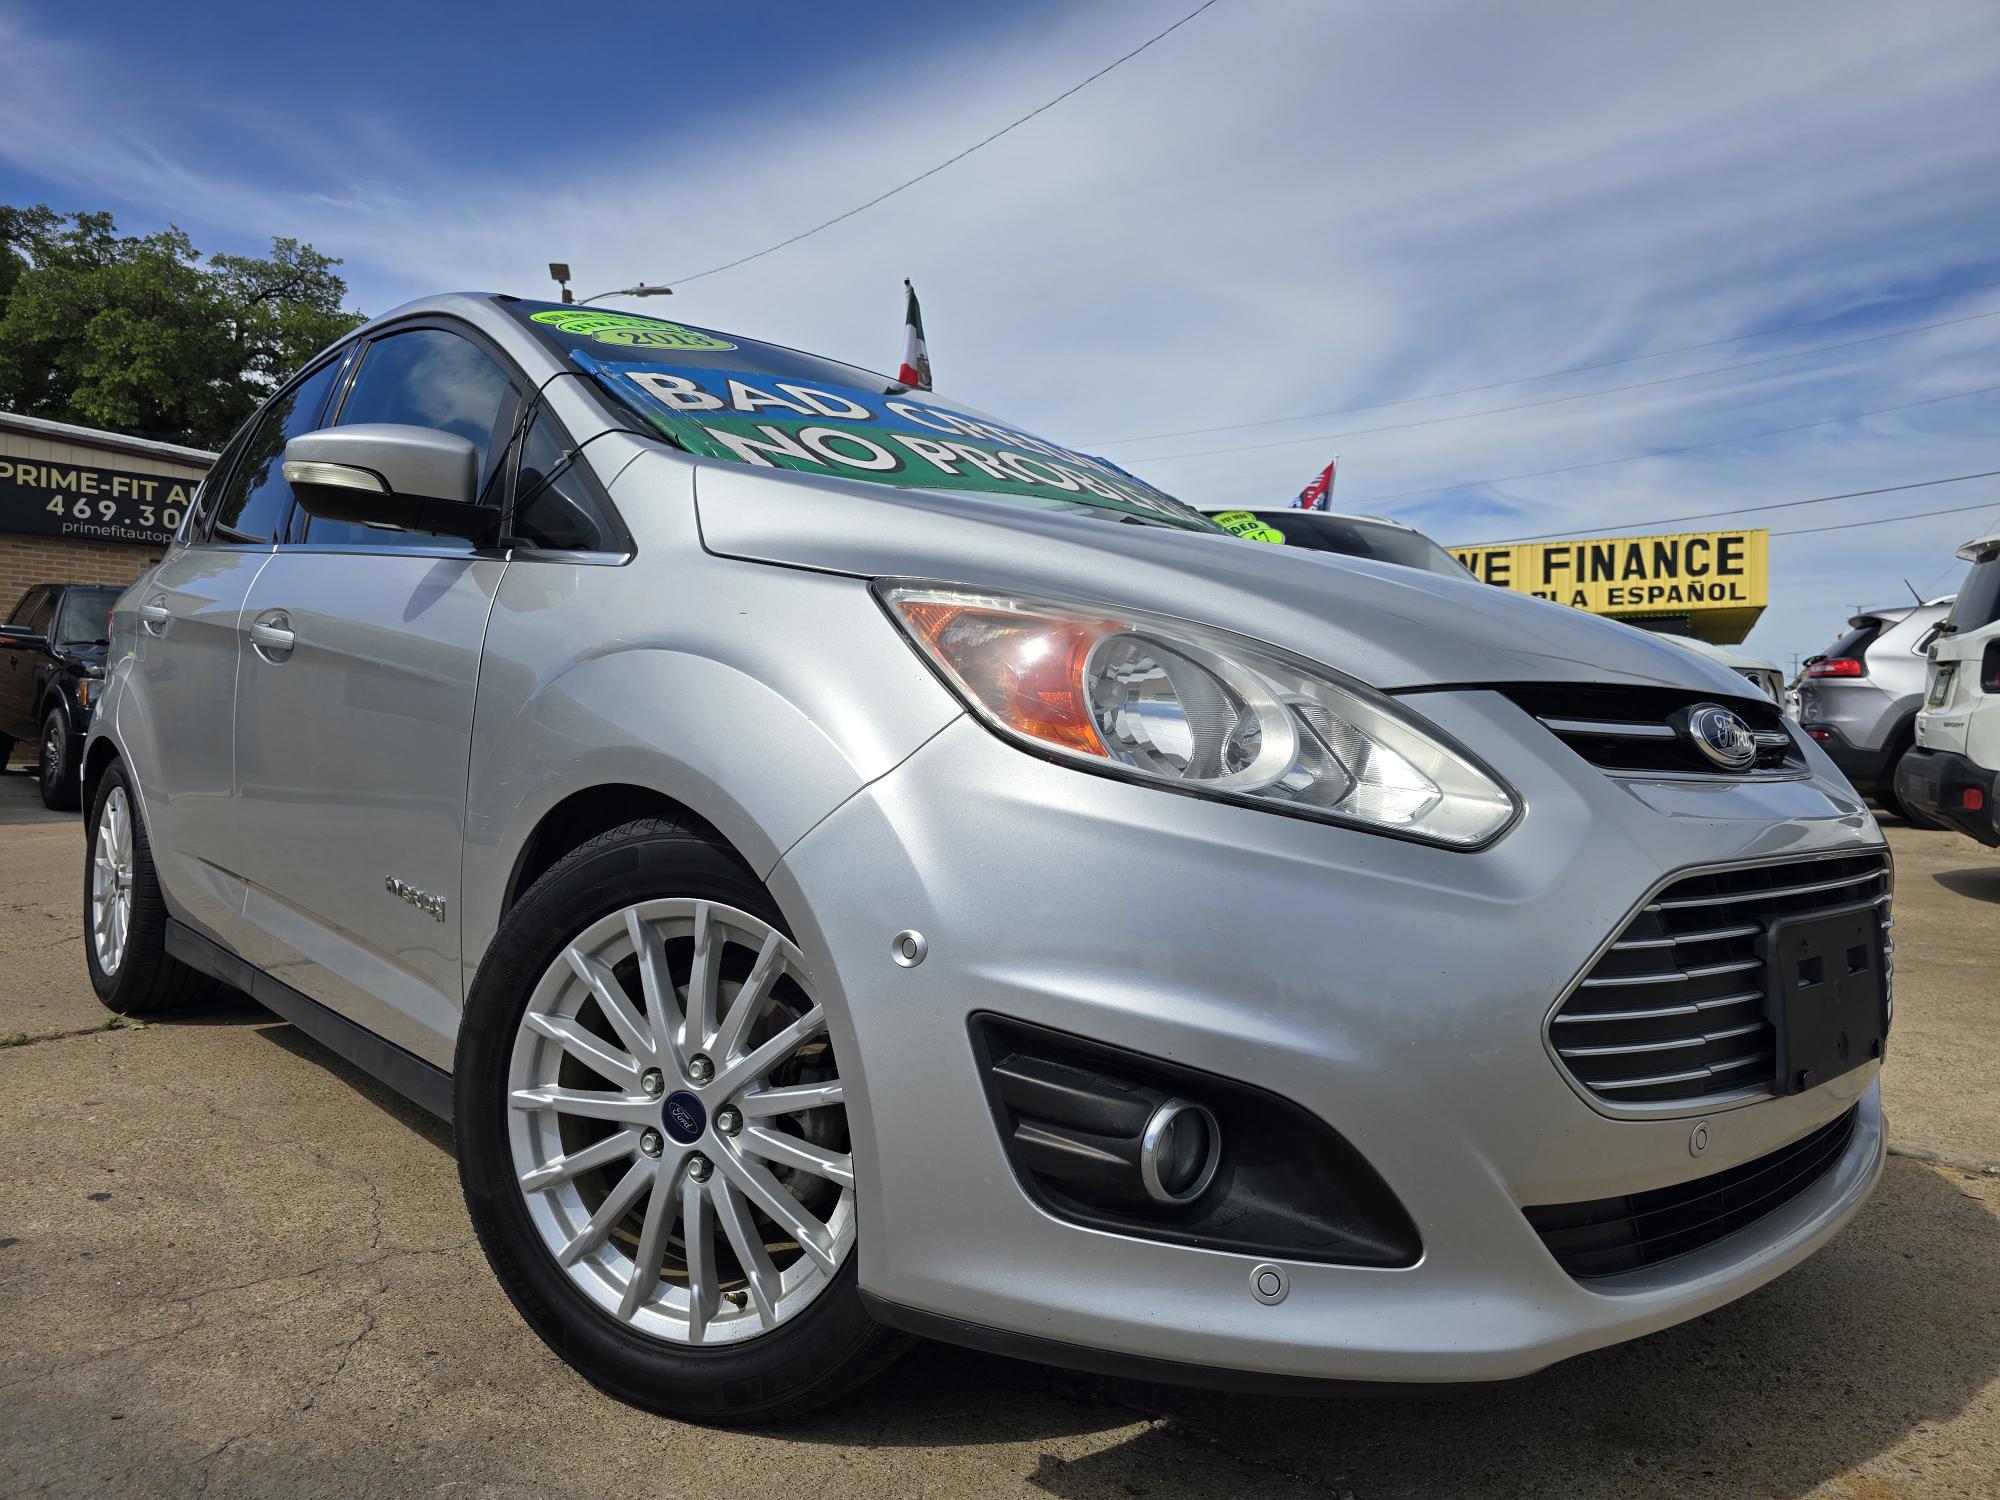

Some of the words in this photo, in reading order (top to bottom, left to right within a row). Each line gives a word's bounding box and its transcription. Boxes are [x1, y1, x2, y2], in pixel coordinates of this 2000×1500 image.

[624, 371, 872, 420] BAD
[703, 425, 897, 471] NO
[0, 461, 159, 502] PRIME-FIT
[166, 484, 196, 506] A
[1543, 536, 1744, 584] FINANCE
[1608, 580, 1747, 606] ESPAÑOL
[672, 1107, 694, 1129] Ford
